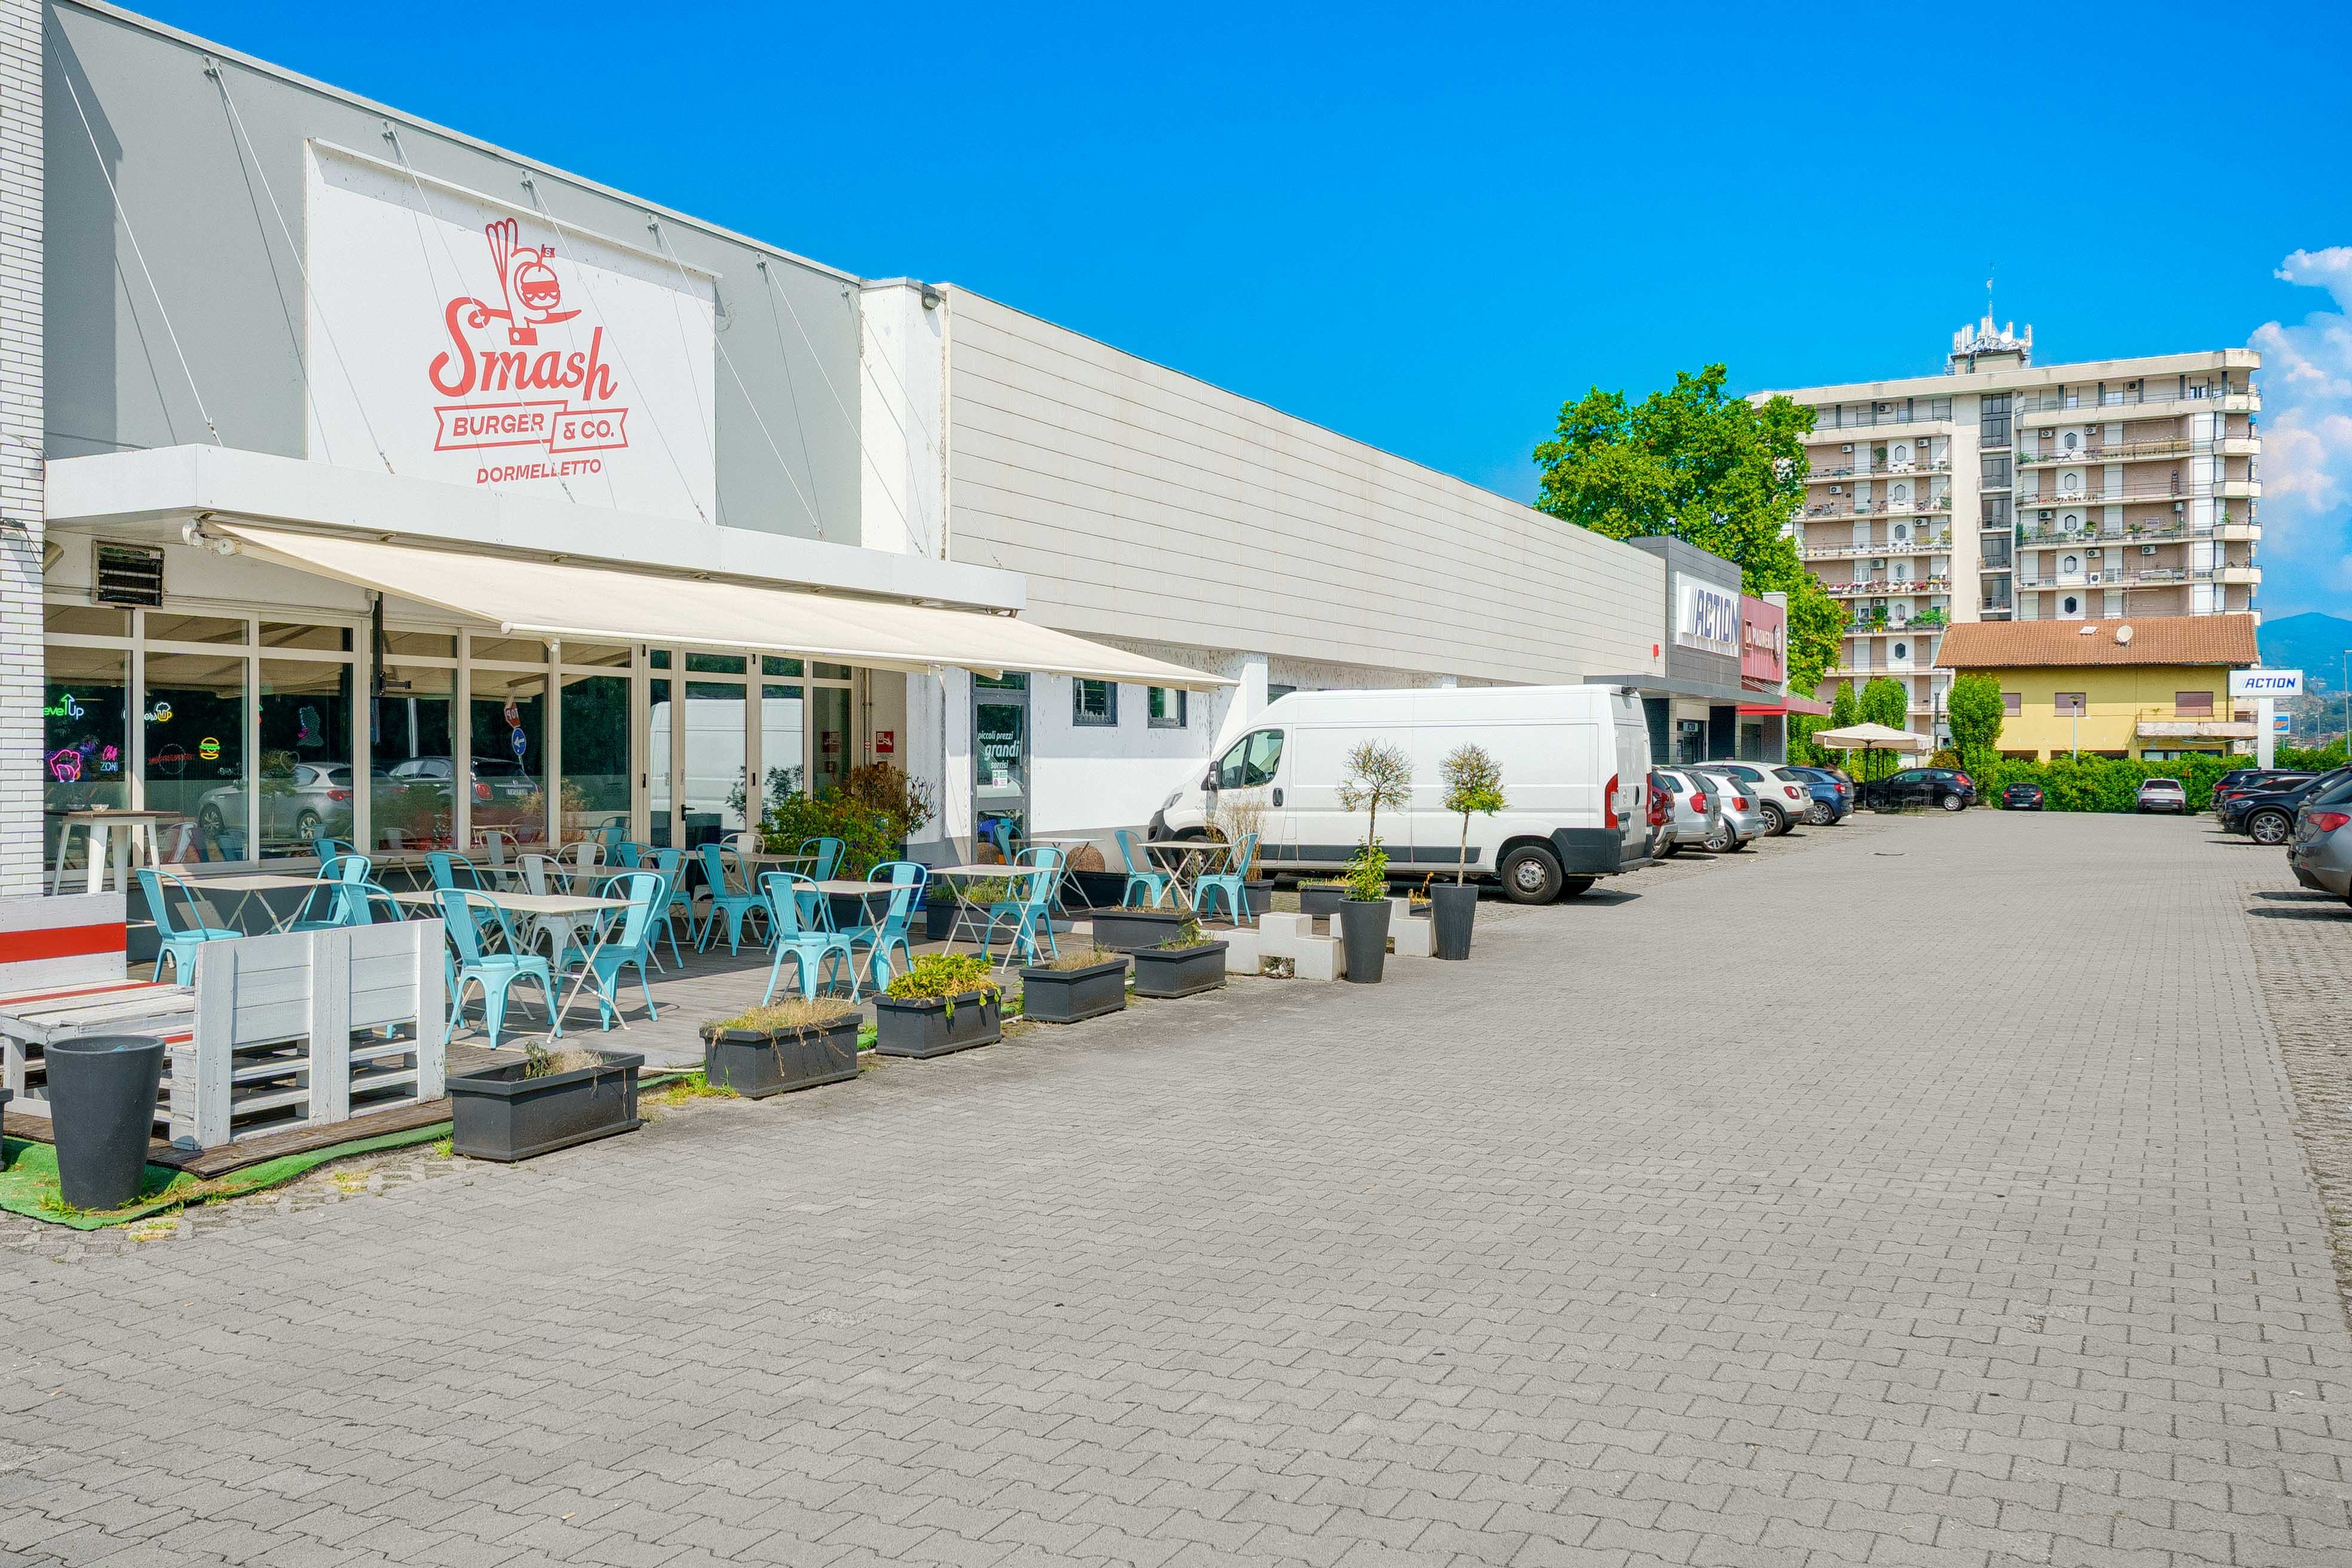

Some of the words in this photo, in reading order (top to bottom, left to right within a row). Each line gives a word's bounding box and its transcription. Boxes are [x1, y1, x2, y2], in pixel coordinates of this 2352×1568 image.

[544, 248, 551, 257] S
[429, 296, 618, 401] Smash
[453, 413, 544, 437] BURGER
[564, 421, 576, 440] &
[581, 419, 615, 439] CO.
[476, 458, 602, 484] DORMELLETTO
[1696, 589, 1738, 644] ACTION
[2245, 678, 2296, 688] ACTION
[43, 698, 68, 716] evel
[978, 730, 996, 741] piccoli
[996, 731, 1013, 741] prezzi
[984, 740, 1020, 761] grandi
[990, 760, 1009, 769] sorrisi
